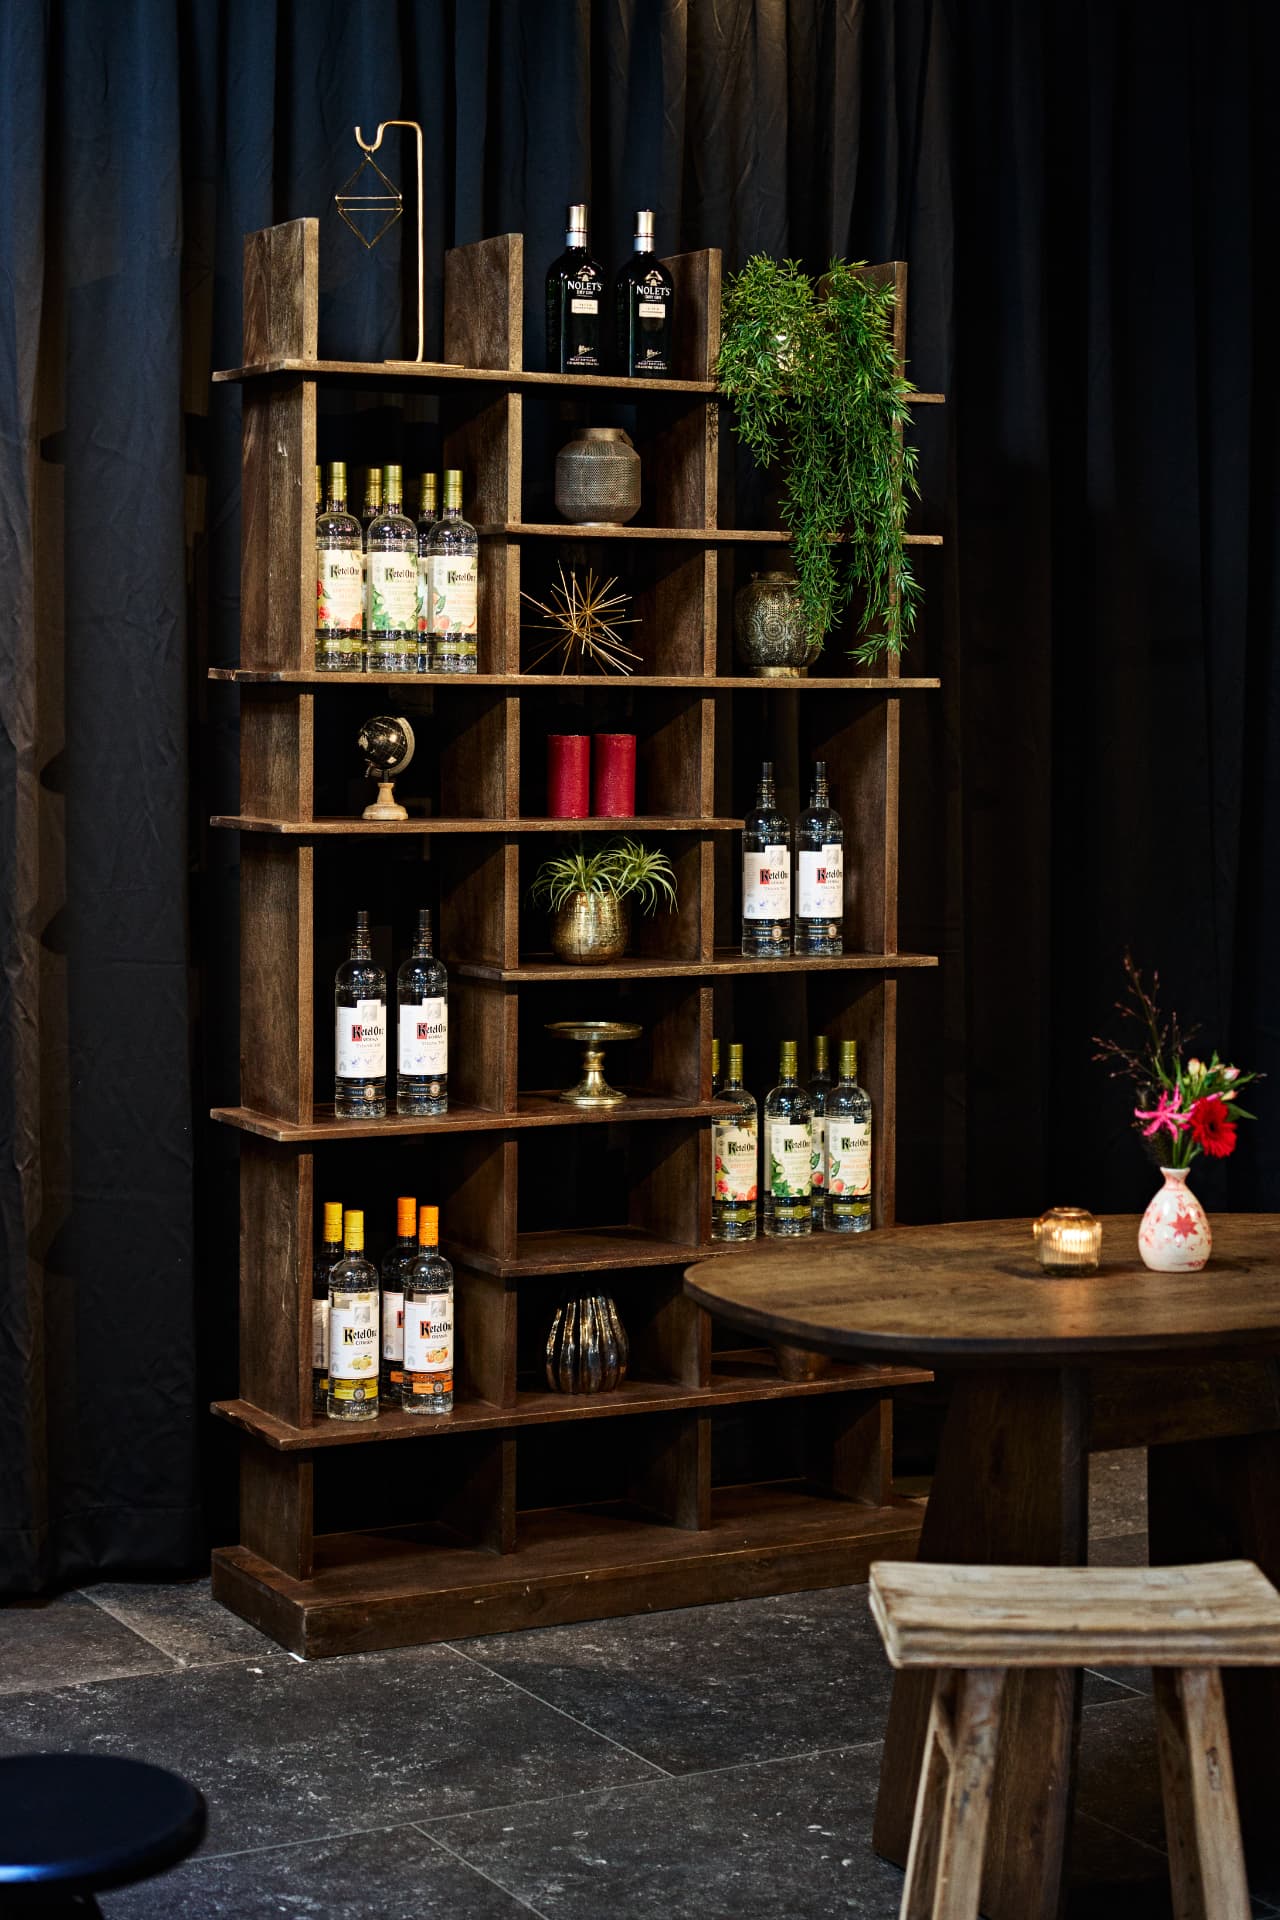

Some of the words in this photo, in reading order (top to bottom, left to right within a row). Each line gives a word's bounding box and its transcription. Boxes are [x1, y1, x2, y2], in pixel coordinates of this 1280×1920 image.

[567, 280, 602, 292] NOLET'S
[636, 285, 671, 296] NOLET'S
[385, 567, 405, 581] Ketel
[761, 869, 780, 882] Ketel
[817, 868, 836, 881] Ketel
[352, 1025, 373, 1039] Ketel
[417, 1023, 439, 1037] Ketel
[728, 1142, 746, 1154] Ketel
[785, 1139, 803, 1152] Ketel
[841, 1137, 859, 1150] Ketel
[421, 1321, 443, 1337] Ketel
[344, 1328, 366, 1344] Ketel
